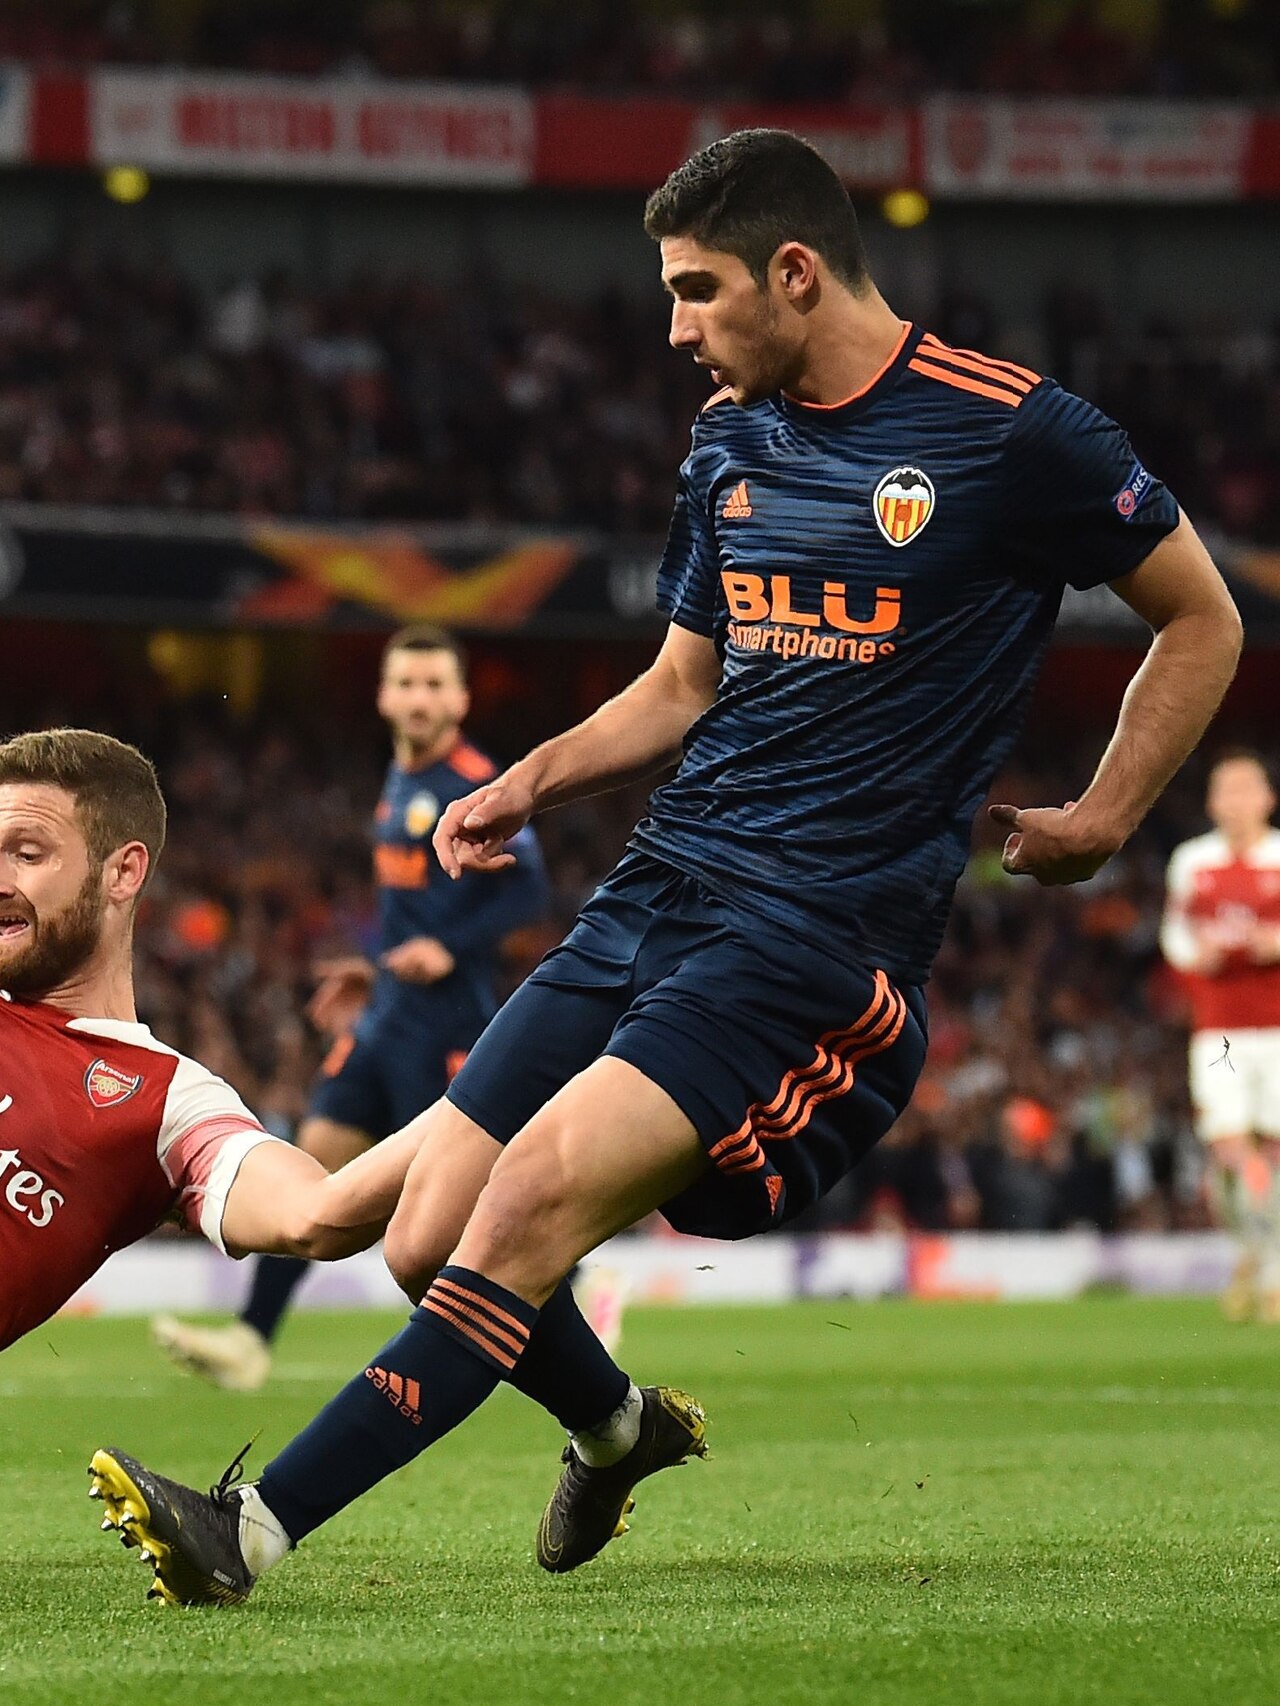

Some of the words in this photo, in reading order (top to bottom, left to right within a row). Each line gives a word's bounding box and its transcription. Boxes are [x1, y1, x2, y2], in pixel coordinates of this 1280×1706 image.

[1131, 466, 1149, 496] RES
[722, 506, 752, 519] adidas
[721, 571, 902, 635] BLU
[727, 623, 896, 663] smartphones
[96, 1063, 136, 1084] Arsenal
[365, 1367, 422, 1424] adidas
